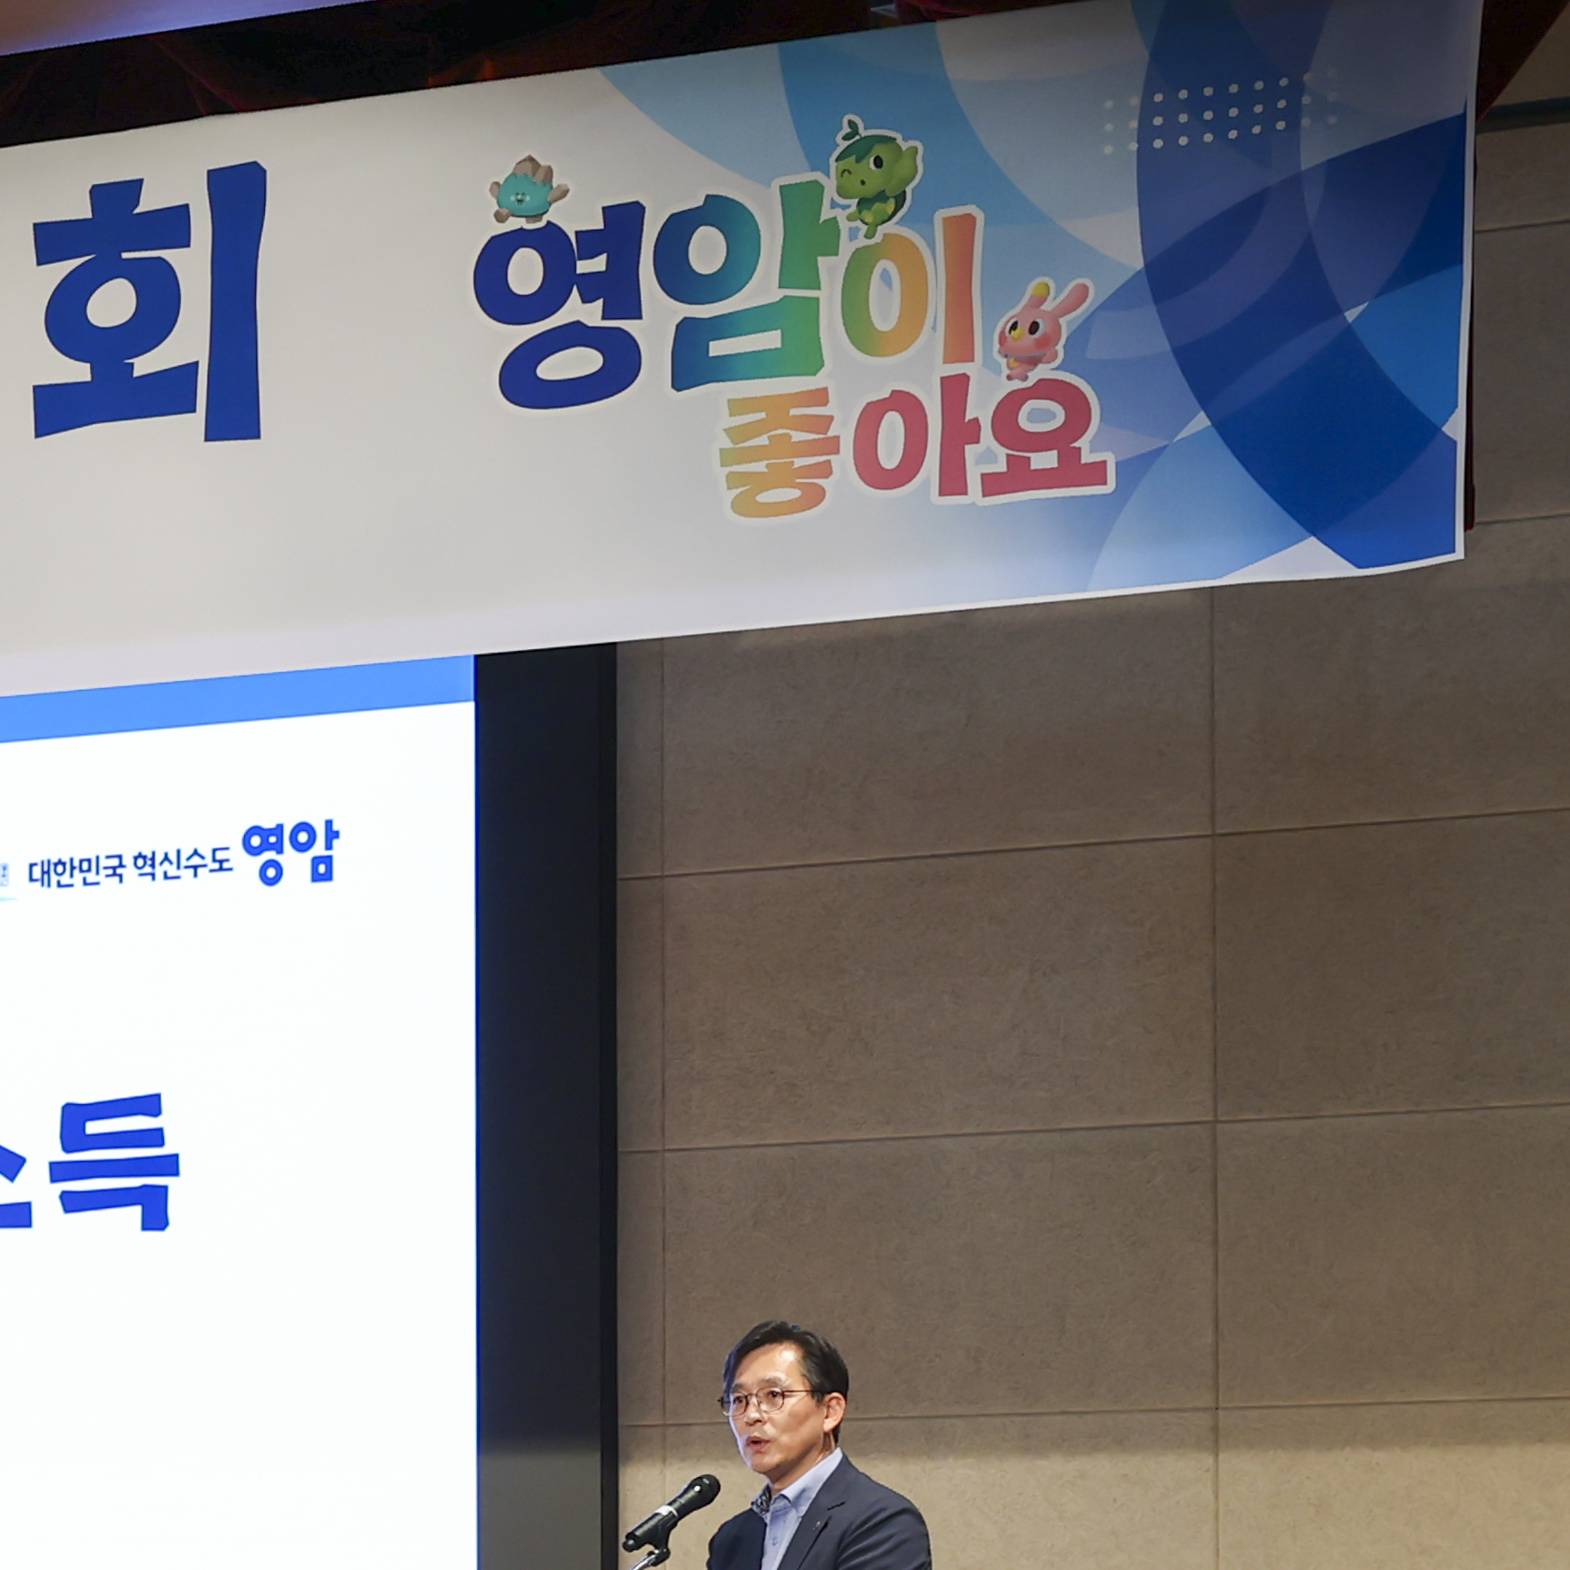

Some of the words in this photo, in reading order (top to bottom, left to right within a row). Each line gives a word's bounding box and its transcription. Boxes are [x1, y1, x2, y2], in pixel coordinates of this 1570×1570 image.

[472, 177, 980, 411] 영암이
[719, 370, 1110, 520] 좋아요
[27, 853, 127, 888] 대한민국
[132, 846, 234, 882] 혁신수도
[241, 818, 341, 887] 영암
